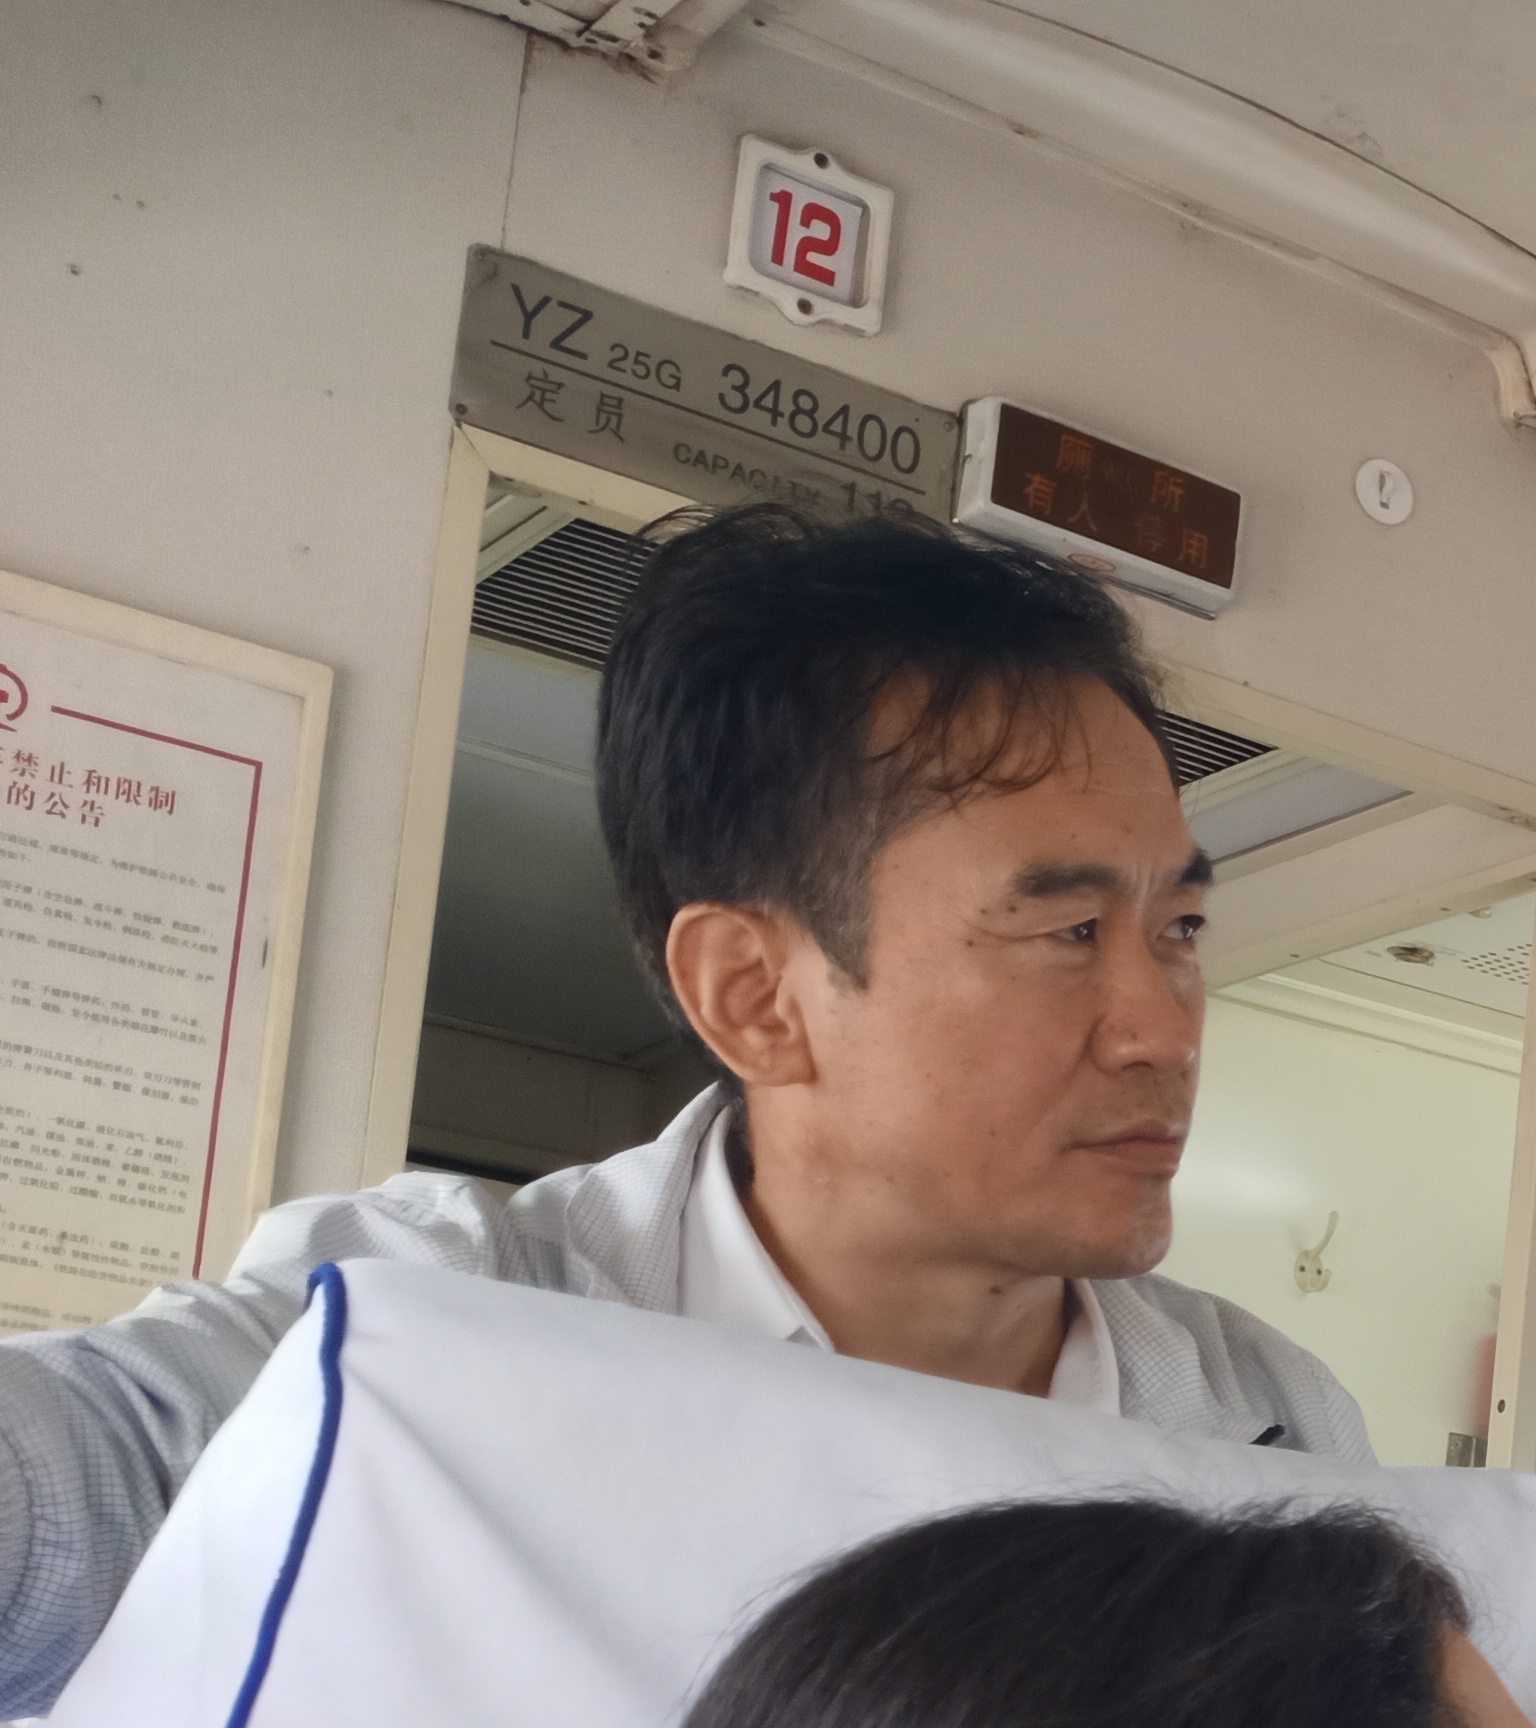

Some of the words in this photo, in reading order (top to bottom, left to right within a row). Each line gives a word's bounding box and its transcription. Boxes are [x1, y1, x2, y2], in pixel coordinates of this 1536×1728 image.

[769, 189, 842, 288] 12
[511, 283, 594, 361] YZ
[607, 342, 683, 393] 25G
[718, 363, 921, 475] 348400
[515, 368, 625, 444] 定员
[1022, 472, 1099, 533] 有人
[0, 748, 177, 817] 禁止和限制
[6, 780, 106, 828] 的公告
